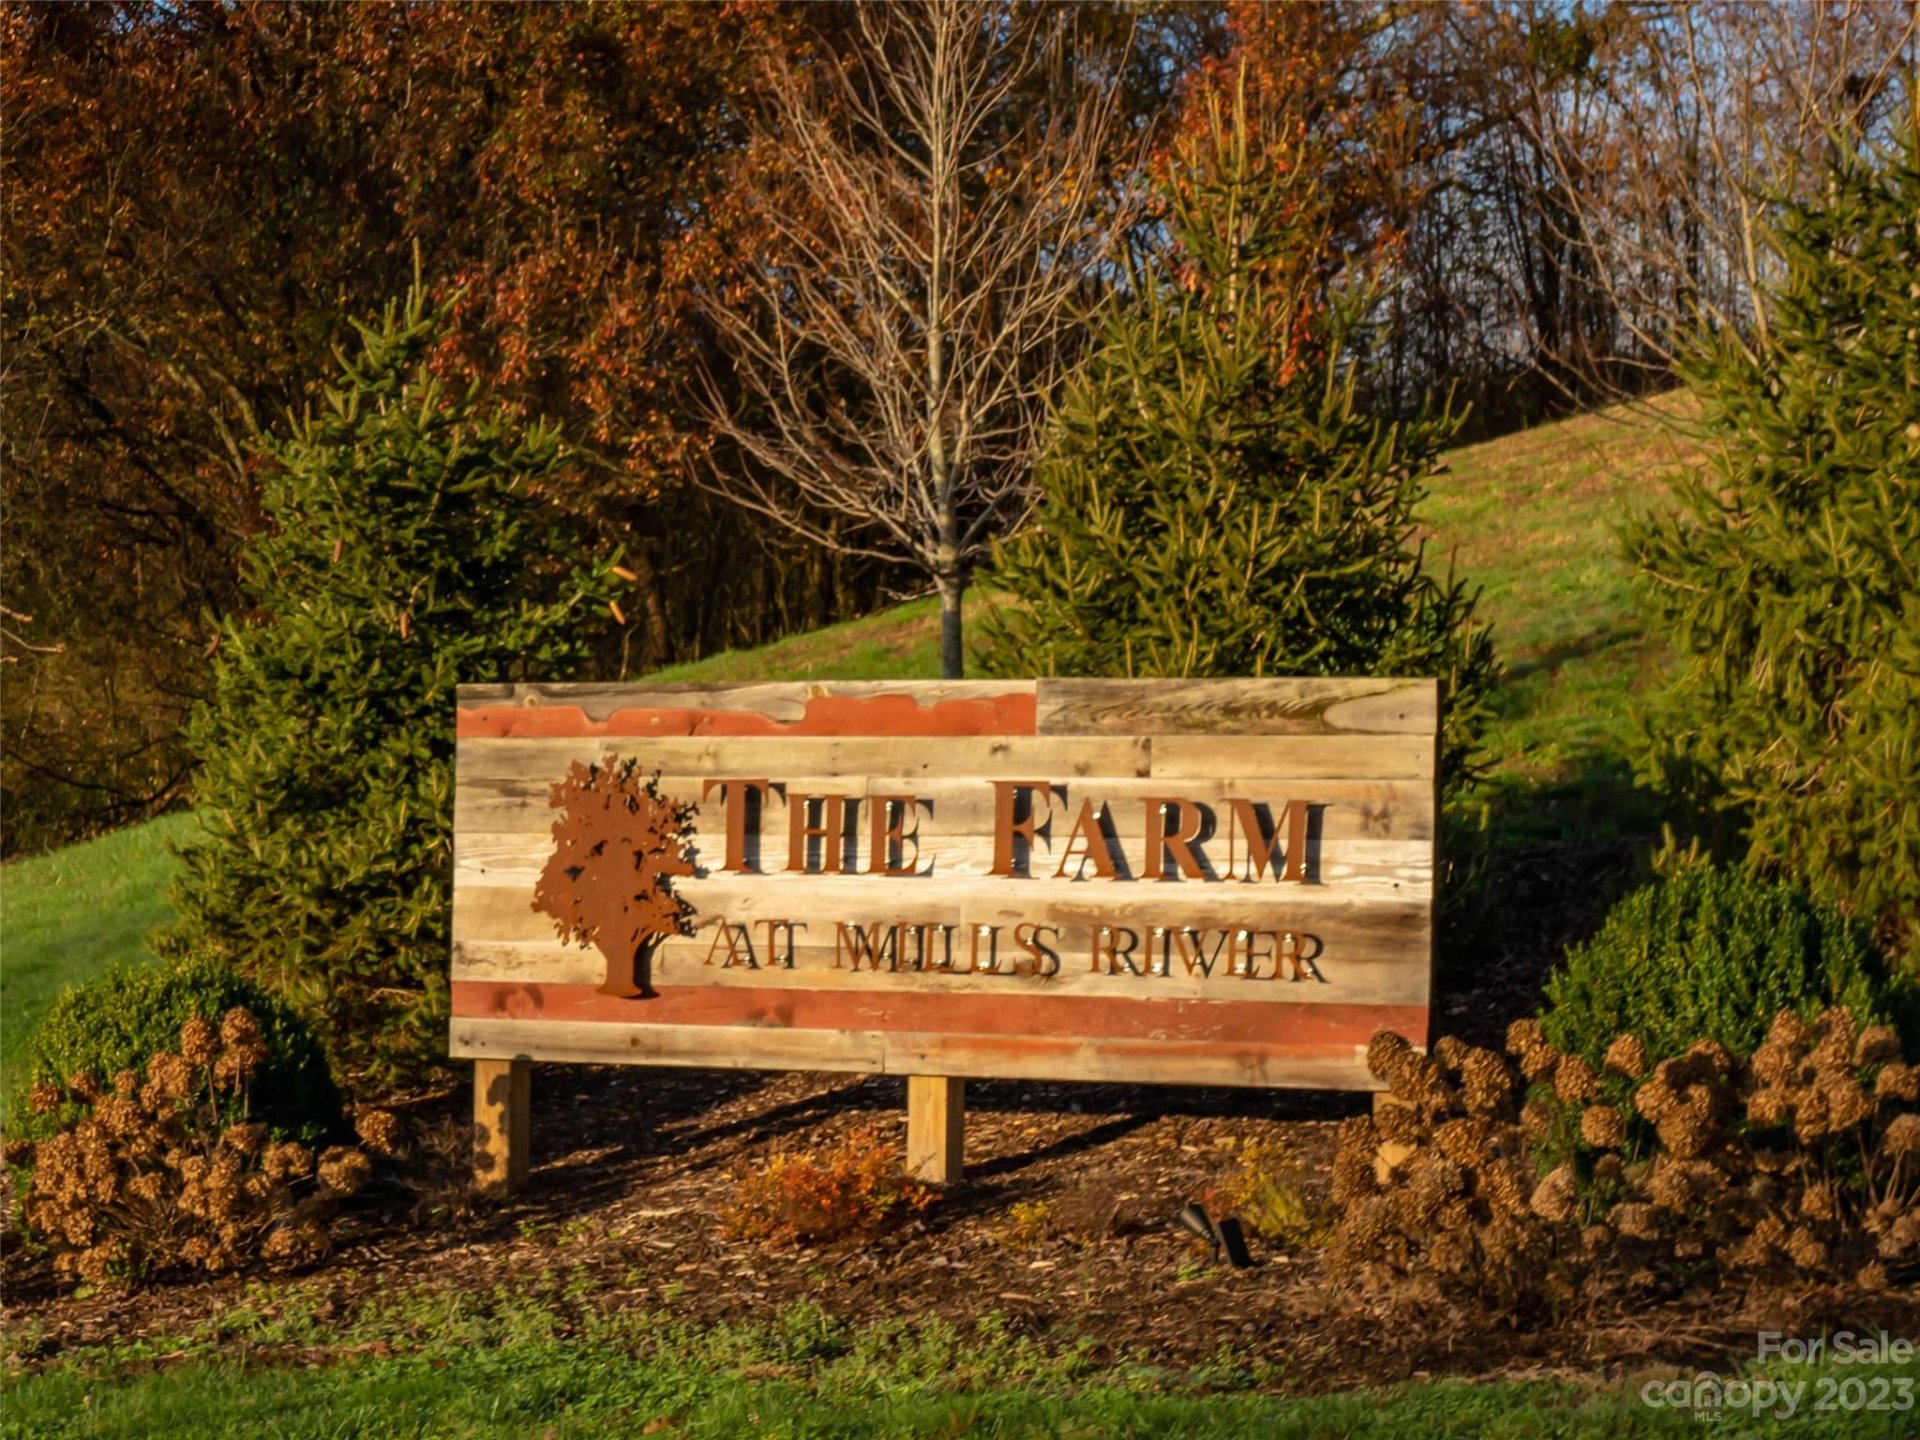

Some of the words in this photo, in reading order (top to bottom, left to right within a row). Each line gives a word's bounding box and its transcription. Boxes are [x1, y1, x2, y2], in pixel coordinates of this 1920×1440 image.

[704, 918, 790, 968] AT
[833, 921, 1046, 976] MILLS
[1091, 924, 1314, 982] RIVER
